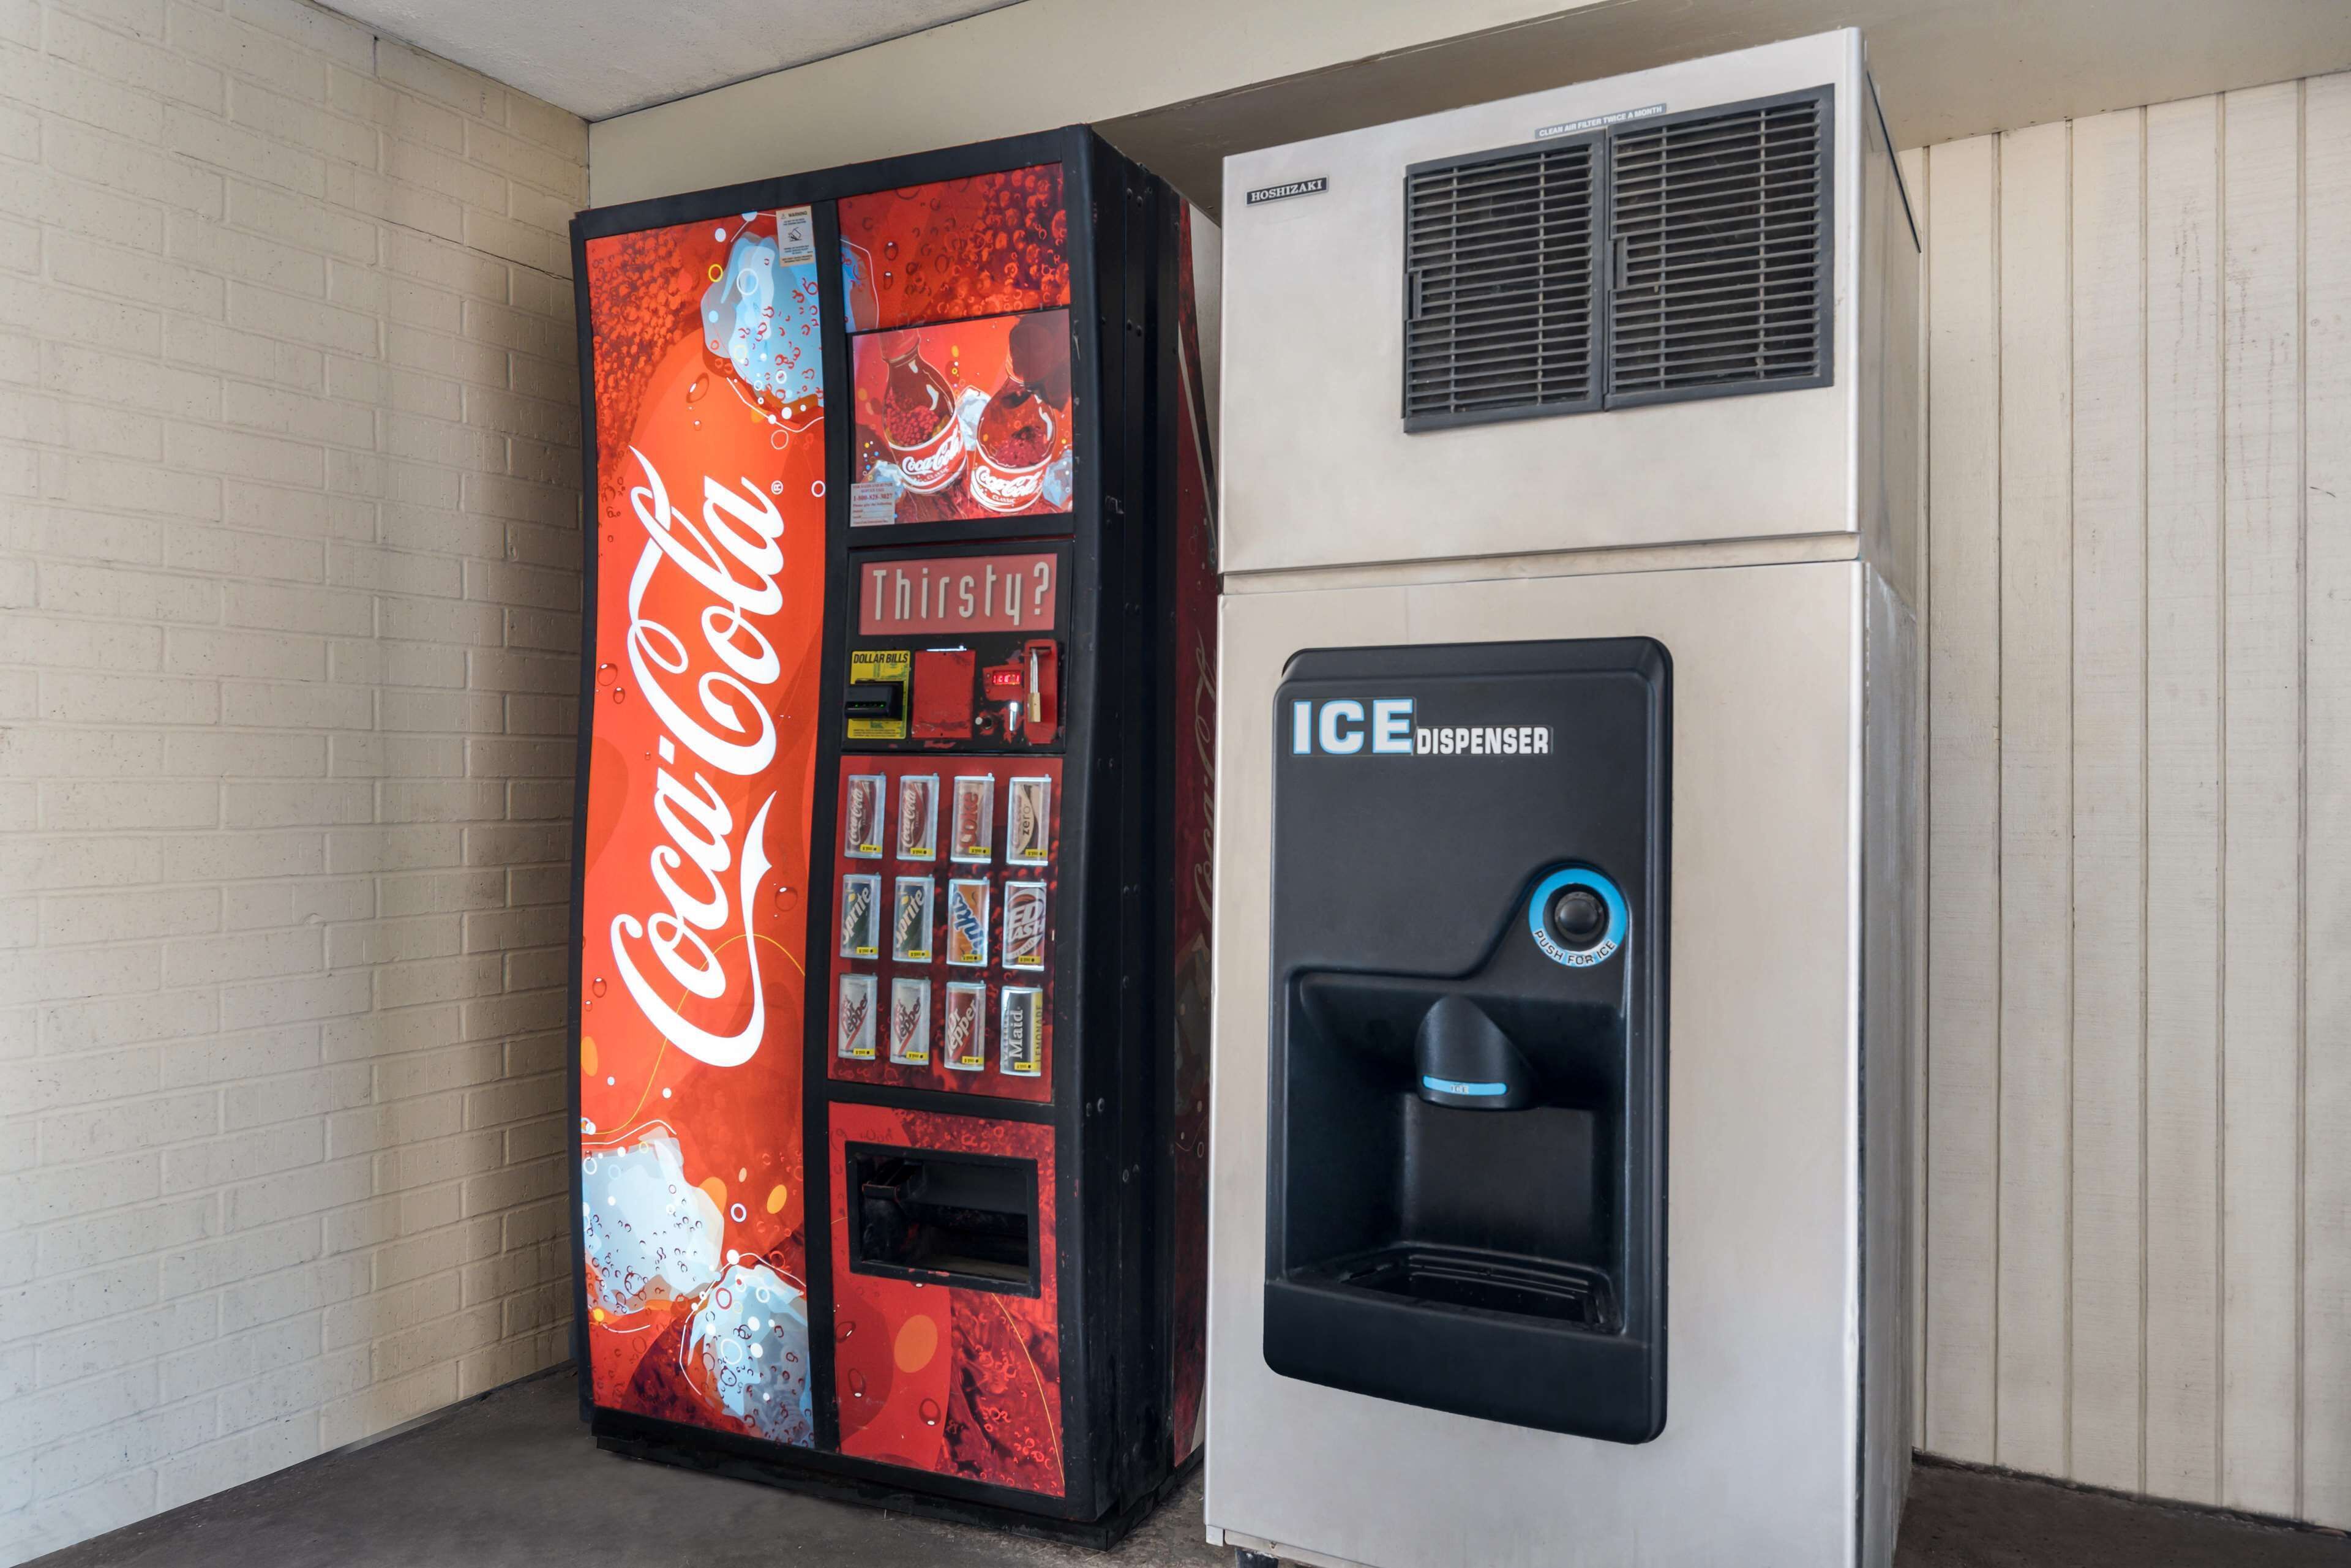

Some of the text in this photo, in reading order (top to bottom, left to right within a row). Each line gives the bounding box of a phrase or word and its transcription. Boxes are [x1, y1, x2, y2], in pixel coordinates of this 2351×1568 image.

[1539, 126, 1562, 137] CLEAN
[1564, 123, 1577, 133] AIR
[1578, 118, 1602, 131] FILTER
[1603, 113, 1626, 124] TWICE
[1634, 105, 1662, 118] MONTH
[1251, 179, 1322, 202] HOSHIZAKI
[873, 561, 1049, 625] Thirsty?
[853, 653, 909, 664] DOLLAR BILLS
[1292, 698, 1549, 755] ICE DISPENSER
[610, 446, 786, 1067] Coca-Cola
[1022, 805, 1031, 836] zero
[1009, 902, 1044, 928] ED
[1534, 930, 1615, 965] PUSH FOR ICE
[1008, 1009, 1023, 1059] Maid
